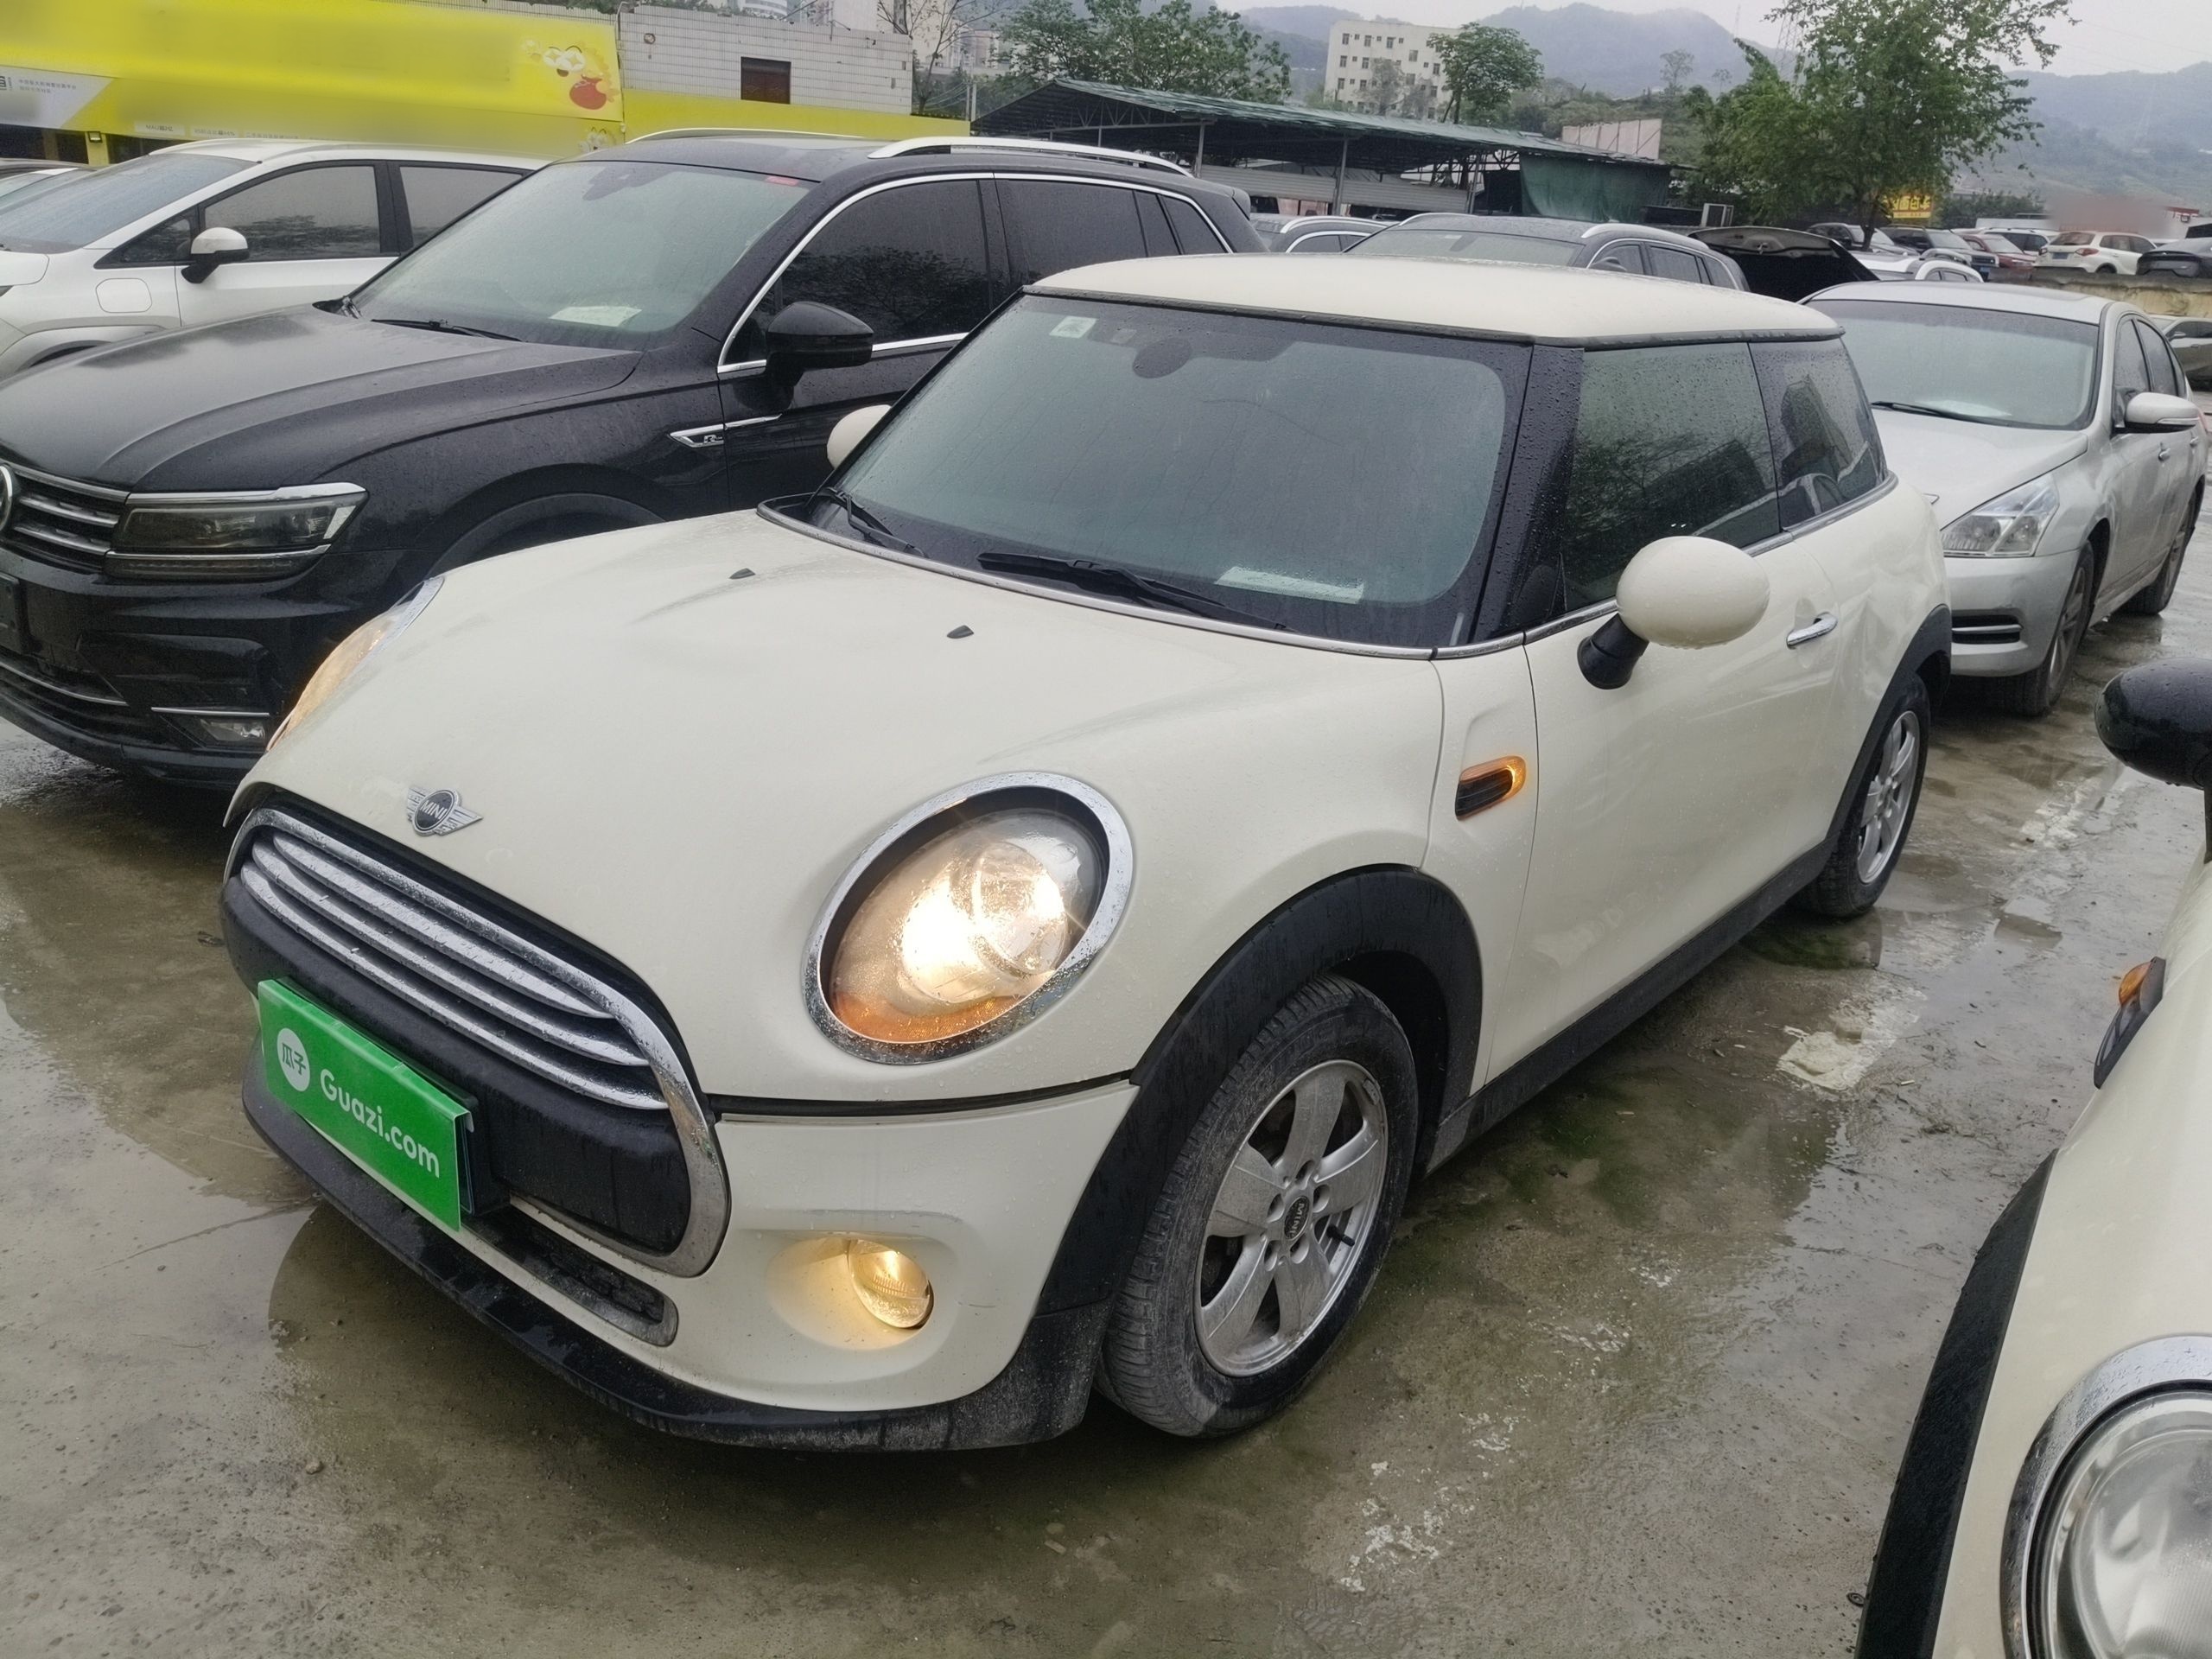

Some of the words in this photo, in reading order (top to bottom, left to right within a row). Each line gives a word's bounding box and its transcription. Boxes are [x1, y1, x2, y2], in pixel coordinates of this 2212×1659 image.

[420, 799, 448, 820] MINI
[281, 1042, 307, 1076] 瓜子
[320, 1068, 440, 1179] Guazi.com
